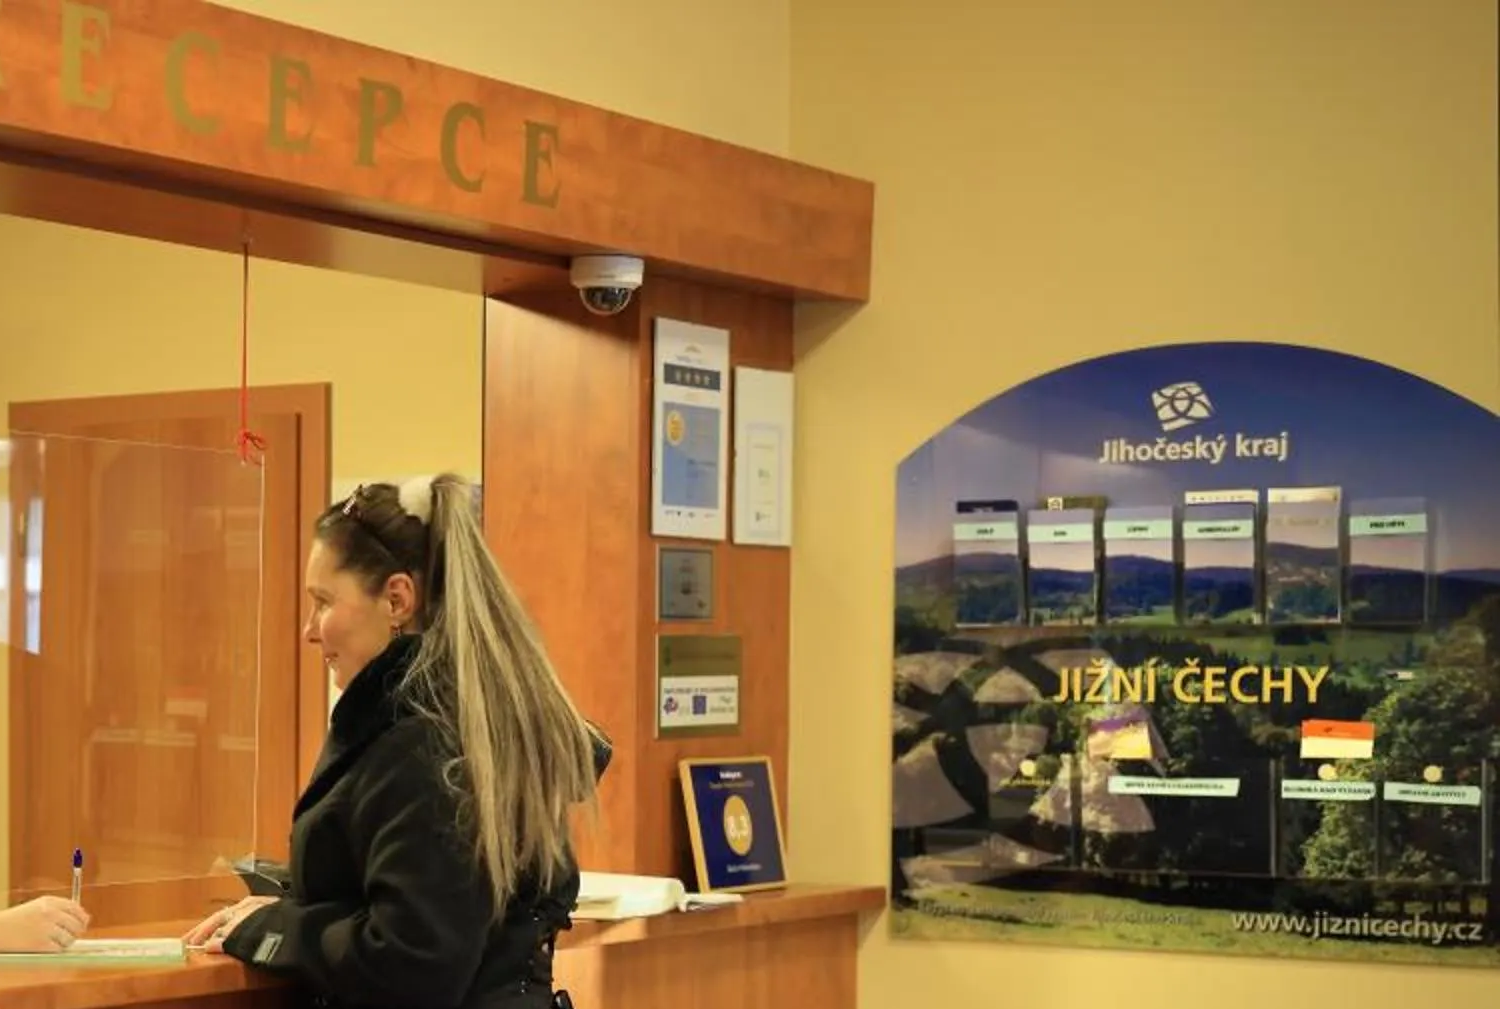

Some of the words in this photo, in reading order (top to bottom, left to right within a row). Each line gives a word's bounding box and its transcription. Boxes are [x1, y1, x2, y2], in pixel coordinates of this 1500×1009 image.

[1099, 434, 1228, 465] Jihočeský
[1235, 431, 1289, 462] kraj
[1054, 657, 1159, 704] JIŽNÍ
[1172, 657, 1329, 704] ČECHY
[1231, 911, 1483, 945] www.jiznicechy.cz
